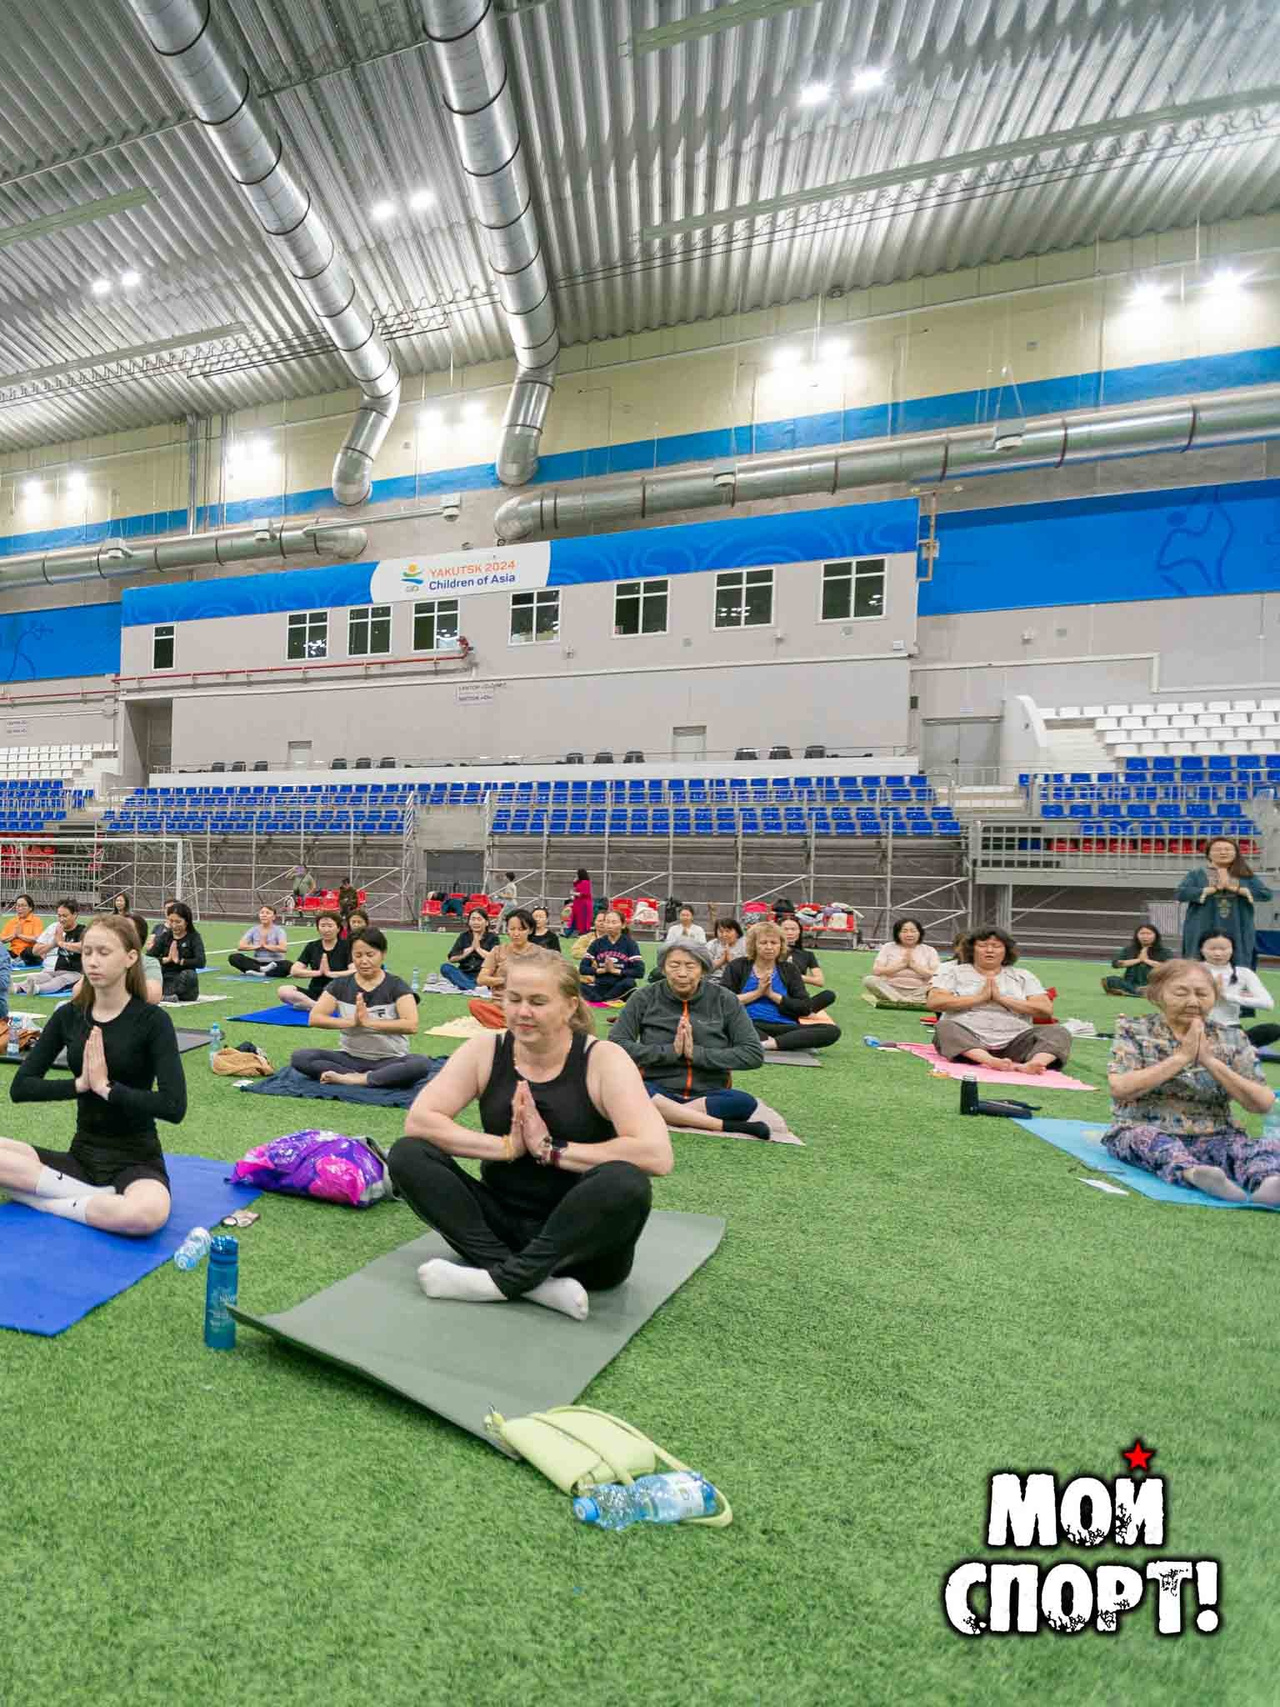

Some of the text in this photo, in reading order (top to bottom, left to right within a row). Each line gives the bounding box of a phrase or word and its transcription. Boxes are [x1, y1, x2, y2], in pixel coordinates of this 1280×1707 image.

[429, 560, 516, 577] YAKUTSK 2024
[429, 573, 516, 590] Children of Asia
